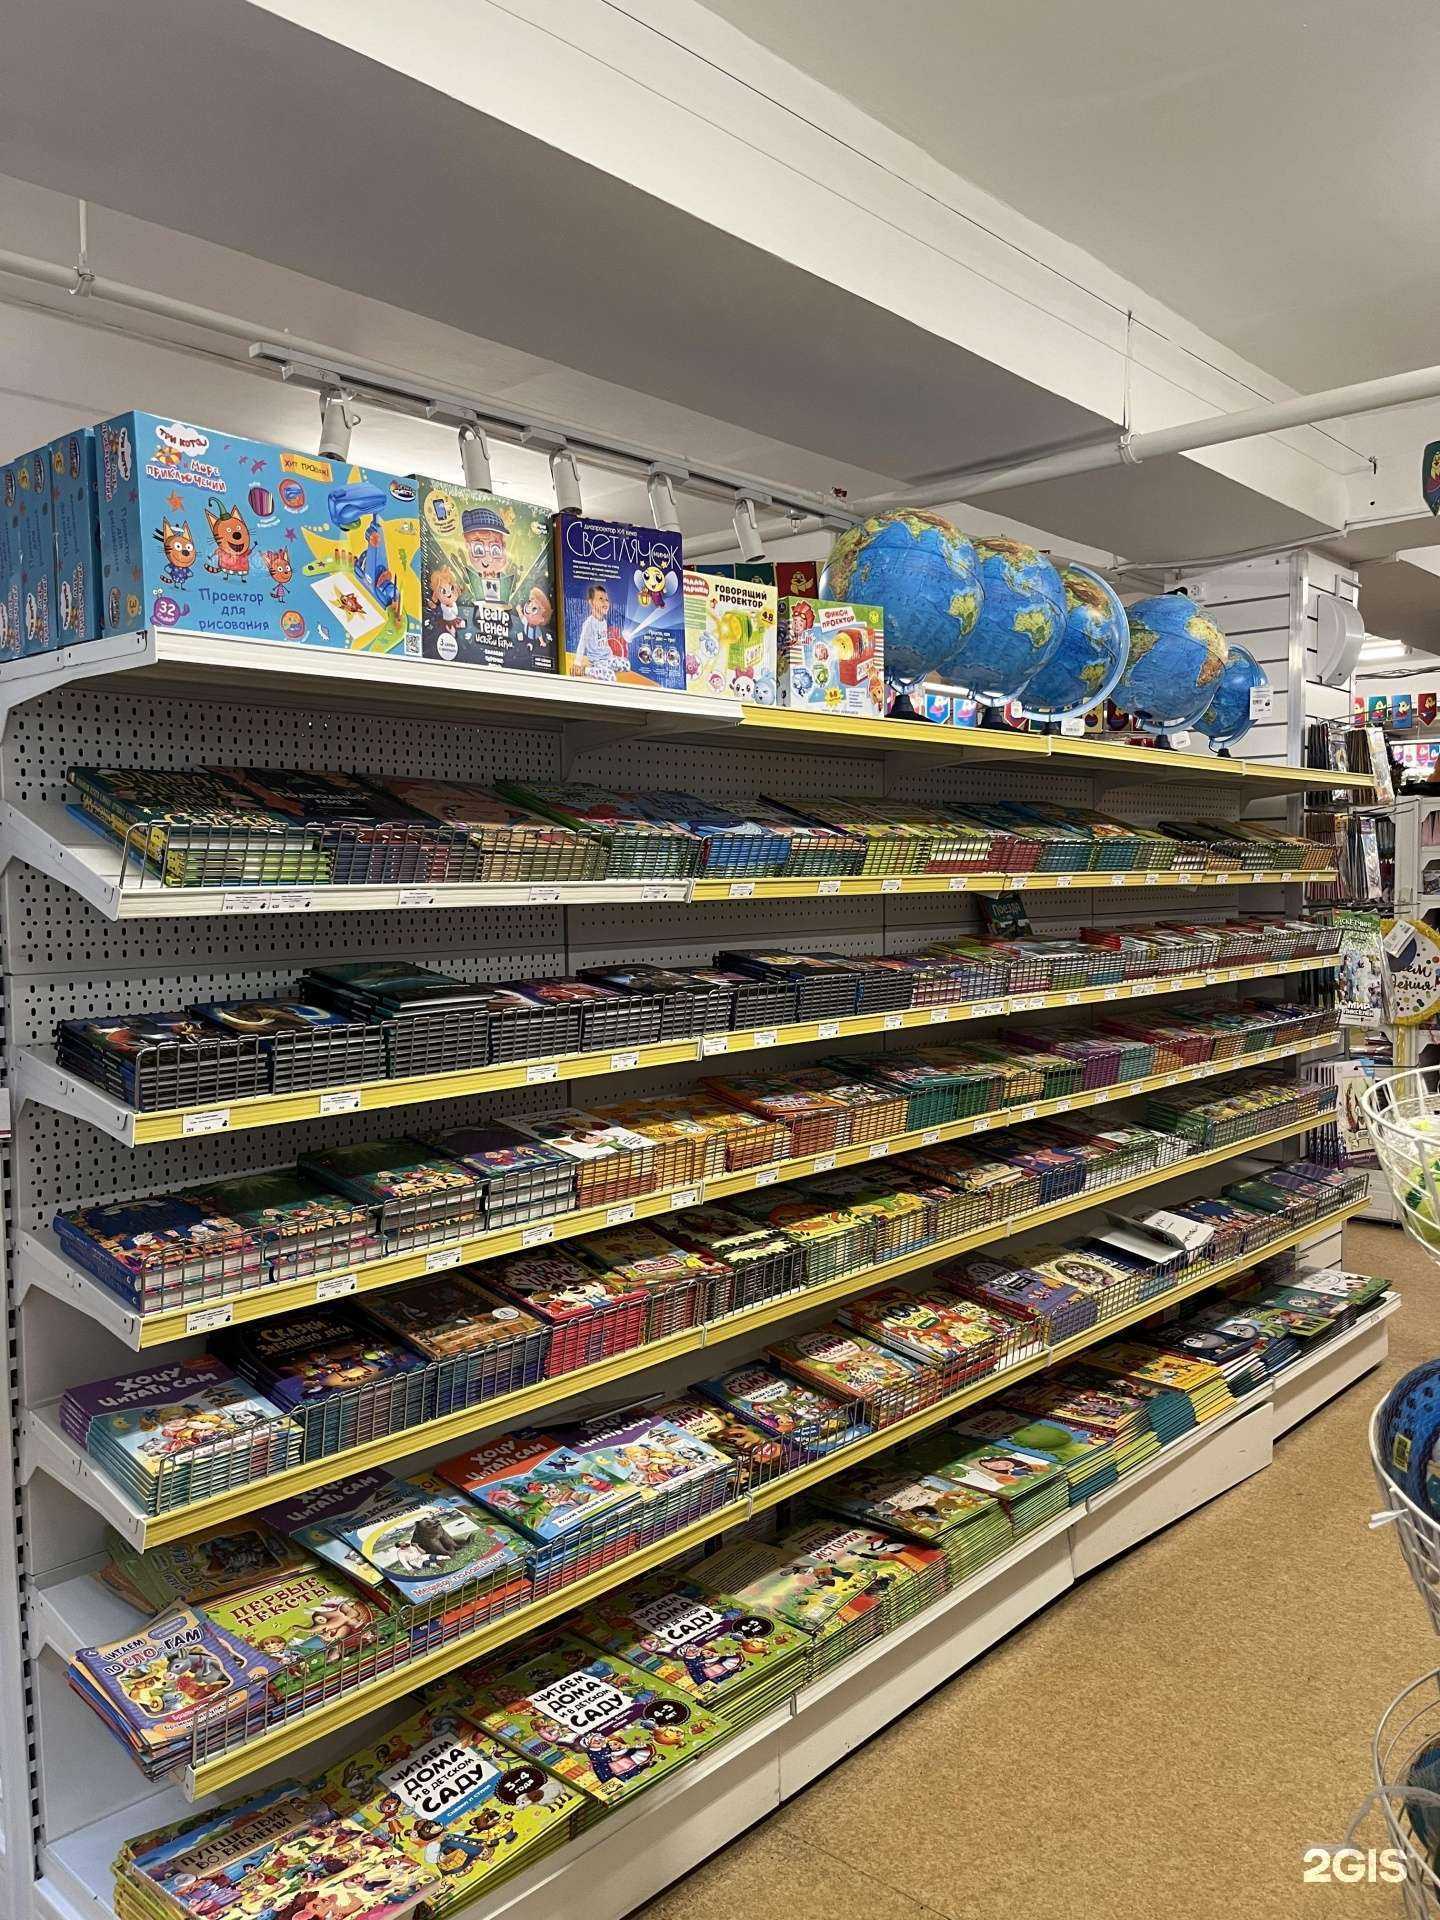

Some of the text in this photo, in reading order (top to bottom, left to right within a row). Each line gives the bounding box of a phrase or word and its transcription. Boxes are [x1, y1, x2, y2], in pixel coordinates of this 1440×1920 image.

[199, 588, 264, 604] Проектор
[715, 584, 767, 601] ГОВОРЯЩИЙ
[719, 594, 764, 609] ПРОЕКТОР
[159, 601, 177, 617] 32
[221, 606, 246, 617] для
[473, 600, 511, 625] Театр
[822, 615, 855, 628] ПРОЕКТОР
[198, 619, 270, 632] рисования
[172, 1372, 219, 1388] САМ
[515, 1443, 548, 1460] САМ
[342, 1475, 380, 1496] САМ
[229, 1576, 320, 1620] ПЕРВЫЕ
[237, 1584, 333, 1628] ТЕКСТЫ
[634, 1595, 682, 1620] ЧИТАЕМ
[647, 1600, 694, 1629] ДОМА
[667, 1611, 714, 1641] САДУ
[103, 1639, 145, 1662] ЧИТАЕМ
[104, 1664, 121, 1675] ПО
[533, 1674, 589, 1702] ЧИТАЕМ
[548, 1681, 601, 1714] ДОМА
[576, 1689, 612, 1712] ДЕТСКОМ
[570, 1693, 624, 1728] САДУ
[390, 1740, 454, 1782] ЧИТАЕМ
[403, 1748, 466, 1796] ДОМА
[412, 1792, 422, 1802] И
[431, 1758, 475, 1791] ДЕТСКОМ
[422, 1763, 484, 1813] САДУ
[180, 1807, 291, 1867] ПУТЕШЕСТВИЕ
[196, 1817, 292, 1870] ВО ВРЕМЕНИ
